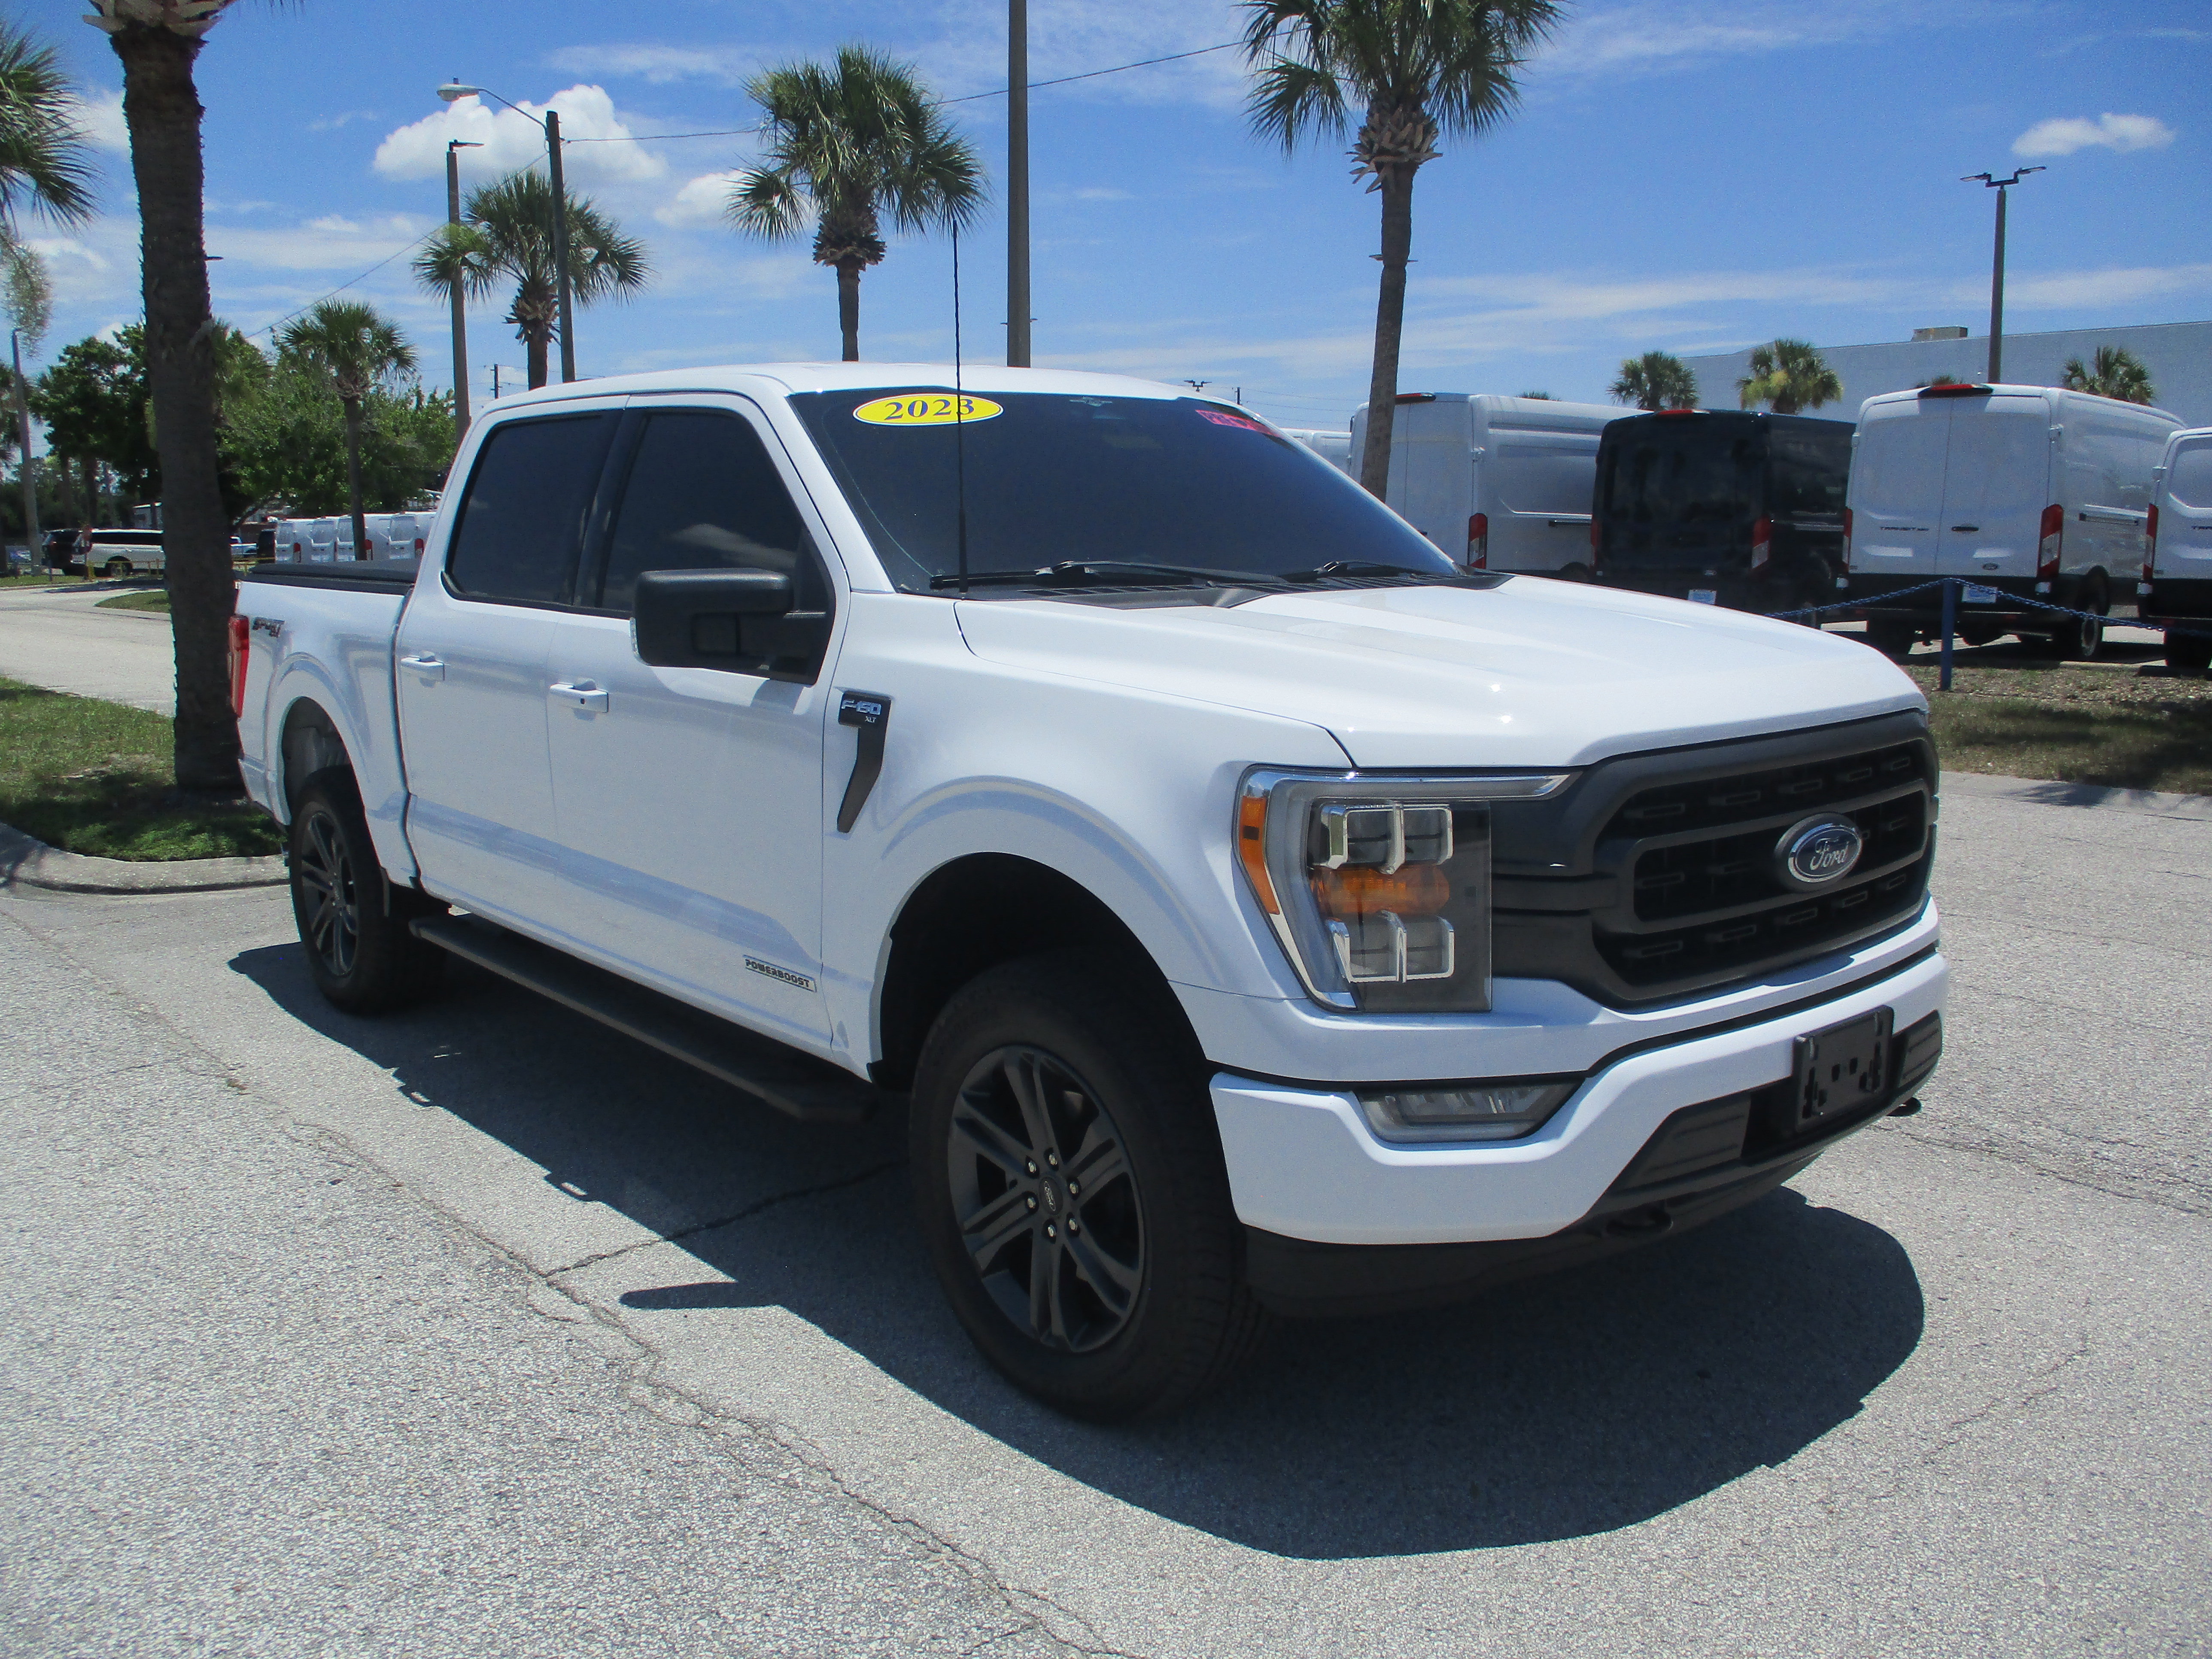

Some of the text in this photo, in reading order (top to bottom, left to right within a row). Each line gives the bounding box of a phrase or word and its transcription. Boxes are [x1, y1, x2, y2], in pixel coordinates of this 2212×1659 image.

[884, 398, 975, 420] 2023
[1809, 836, 1850, 870] Ford
[745, 959, 809, 987] POWERBOOST
